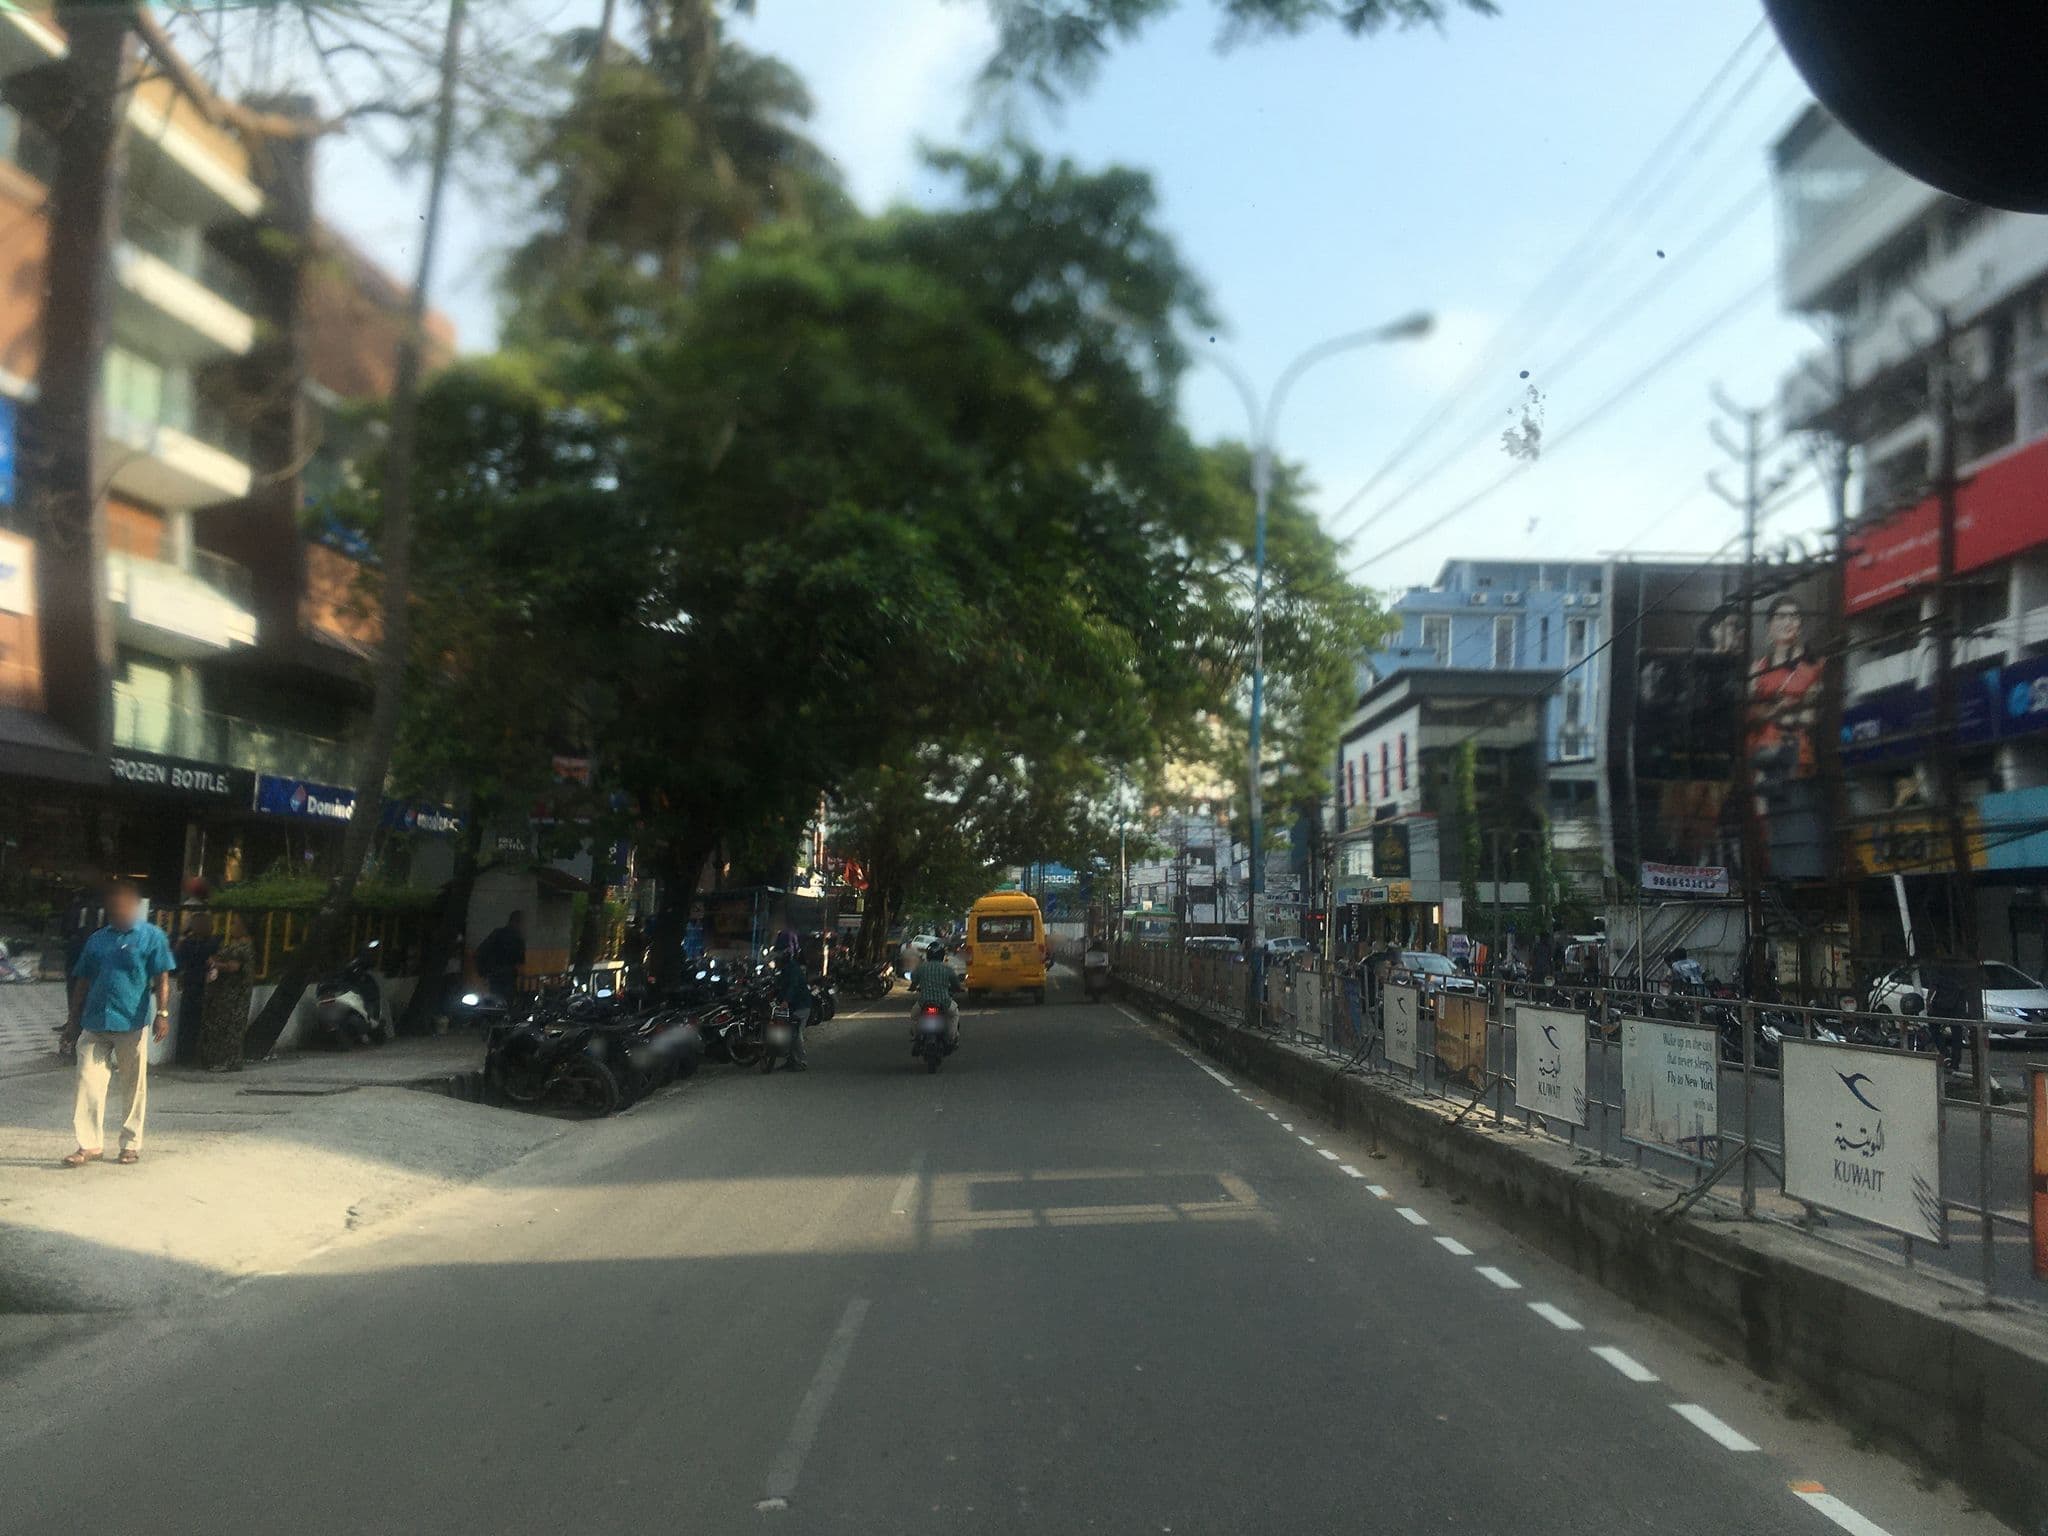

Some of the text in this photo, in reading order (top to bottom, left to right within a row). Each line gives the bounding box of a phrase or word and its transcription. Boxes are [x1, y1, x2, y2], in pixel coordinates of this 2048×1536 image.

[171, 767, 229, 793] BOTTLE
[1538, 1081, 1561, 1099] KUWAIT
[1667, 1070, 1714, 1091] Fly to New York
[1833, 1159, 1885, 1193] KUWAIT
